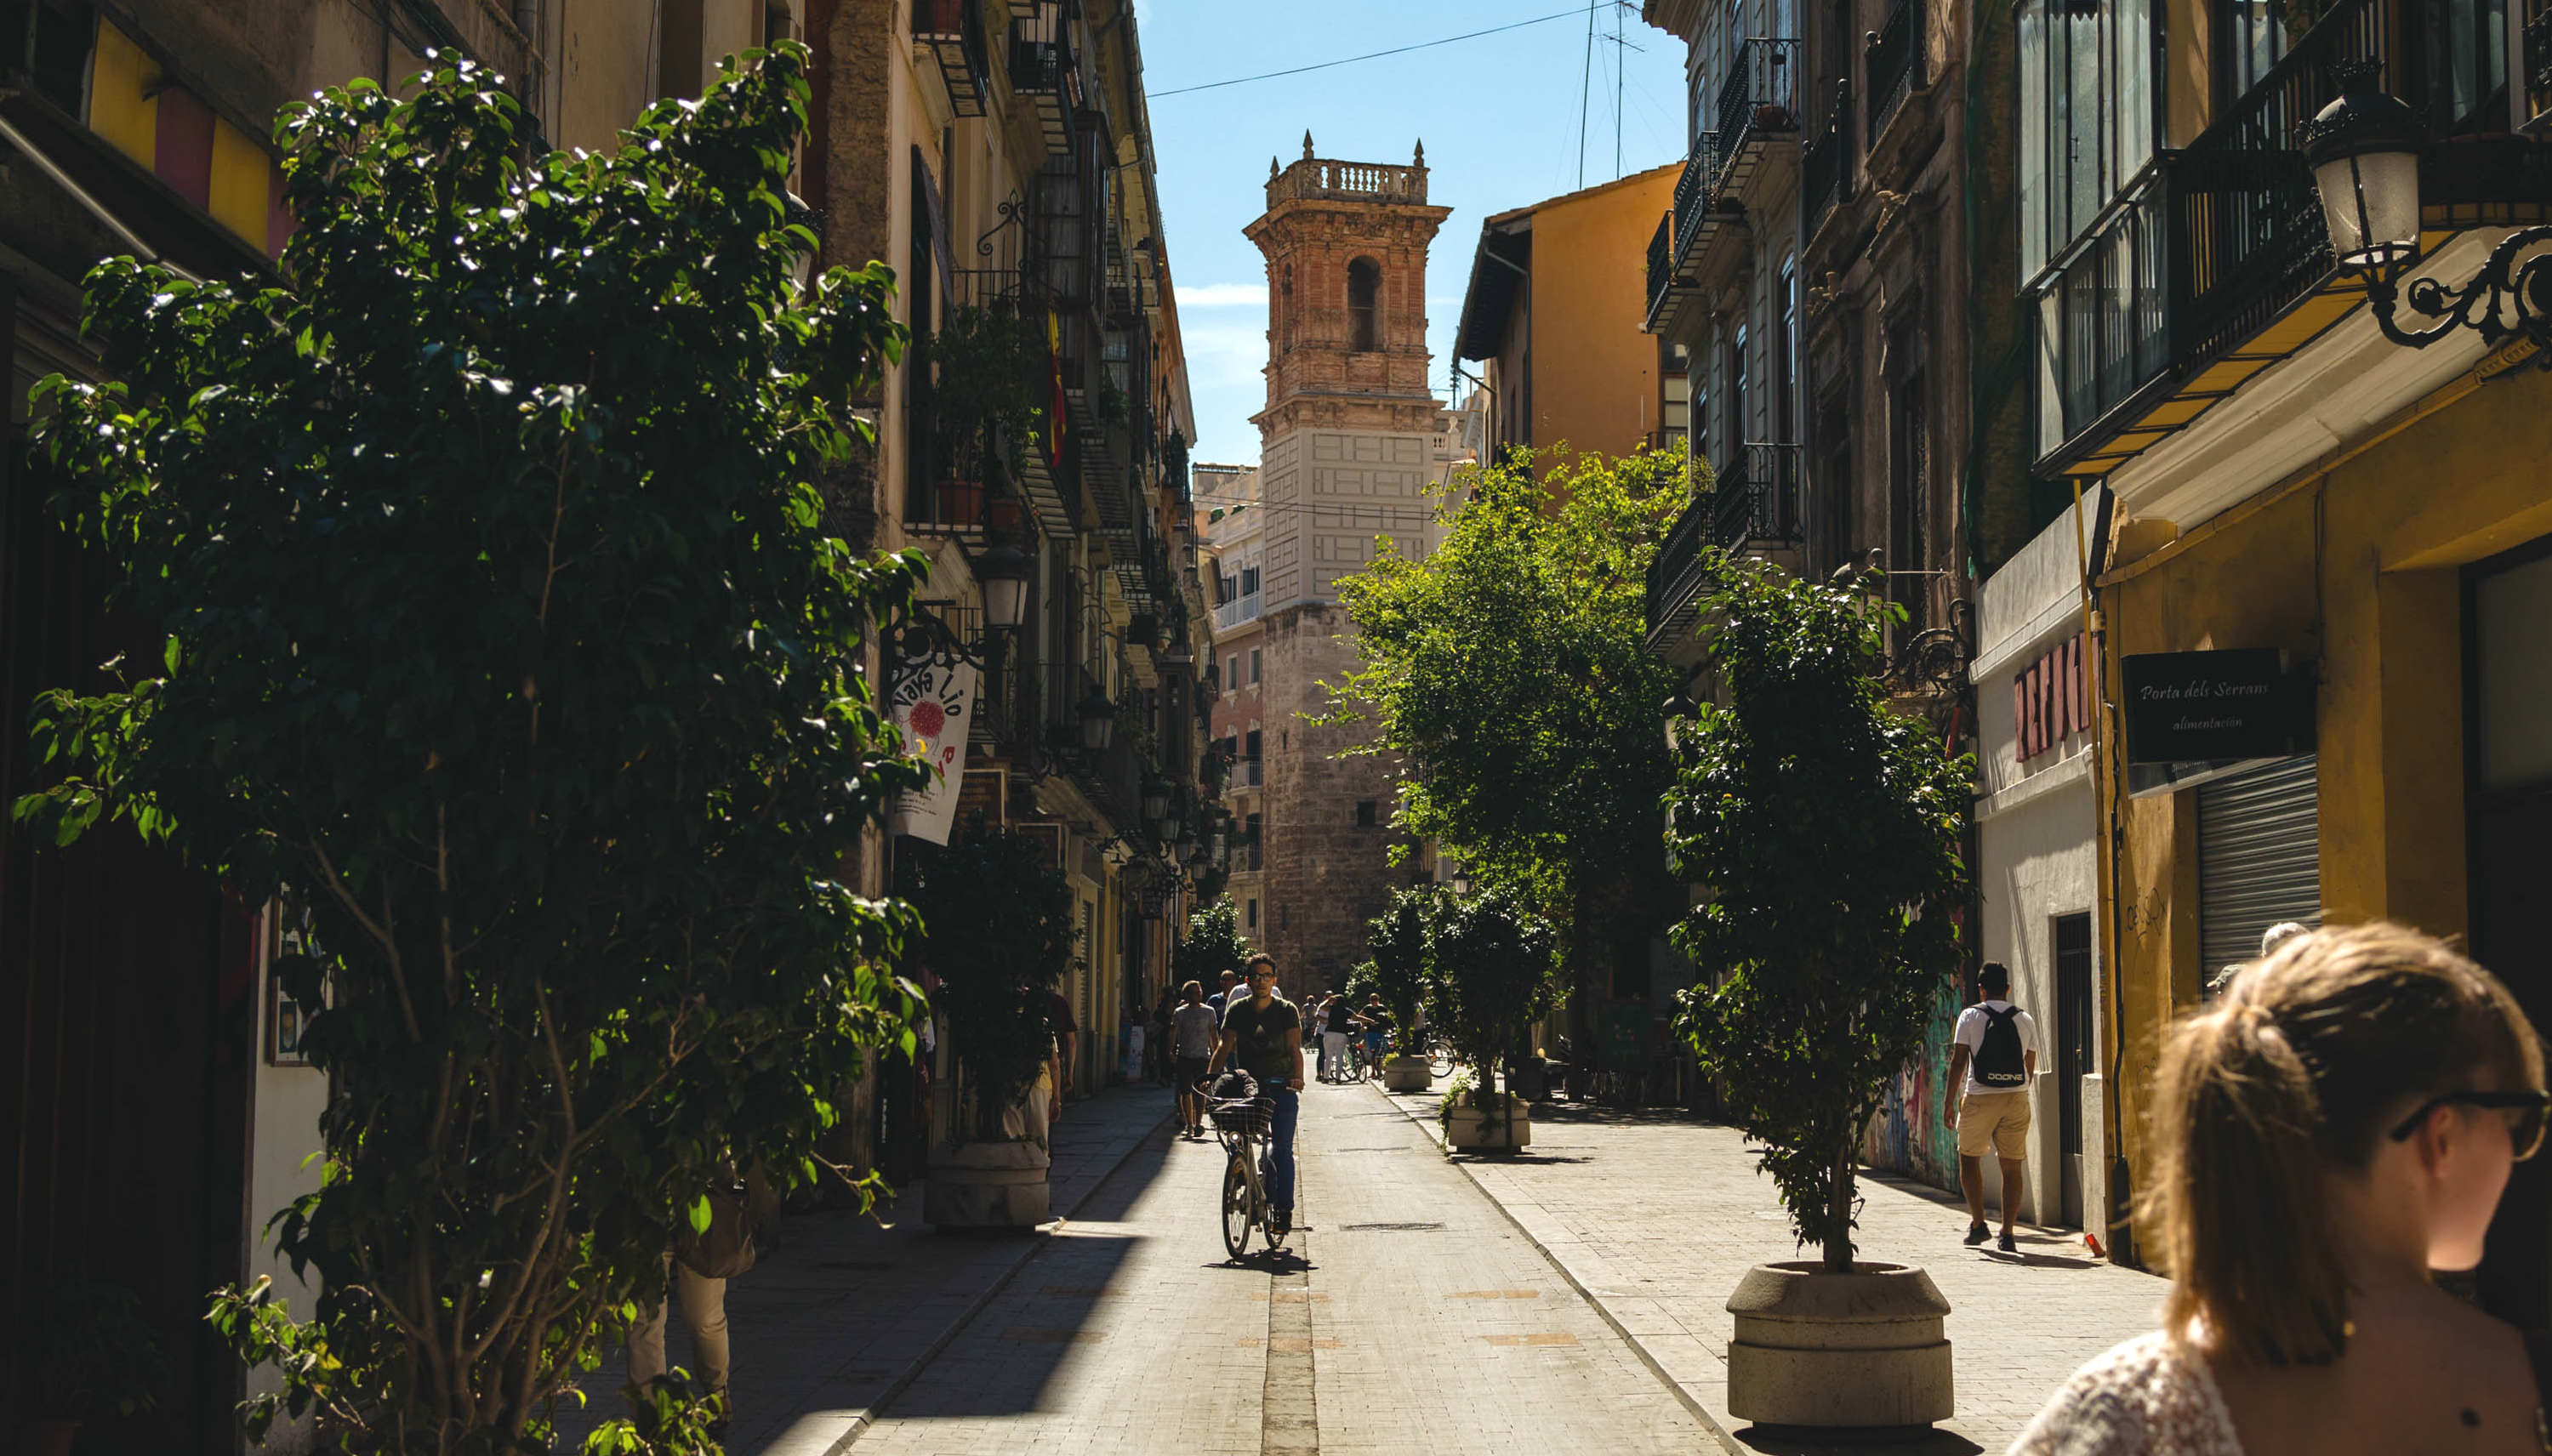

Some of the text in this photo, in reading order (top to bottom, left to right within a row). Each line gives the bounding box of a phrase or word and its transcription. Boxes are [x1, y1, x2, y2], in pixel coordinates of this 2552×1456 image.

[894, 671, 933, 707] Vaya
[2140, 680, 2269, 701] Porta dels Serrans
[2172, 715, 2243, 731] alimentación
